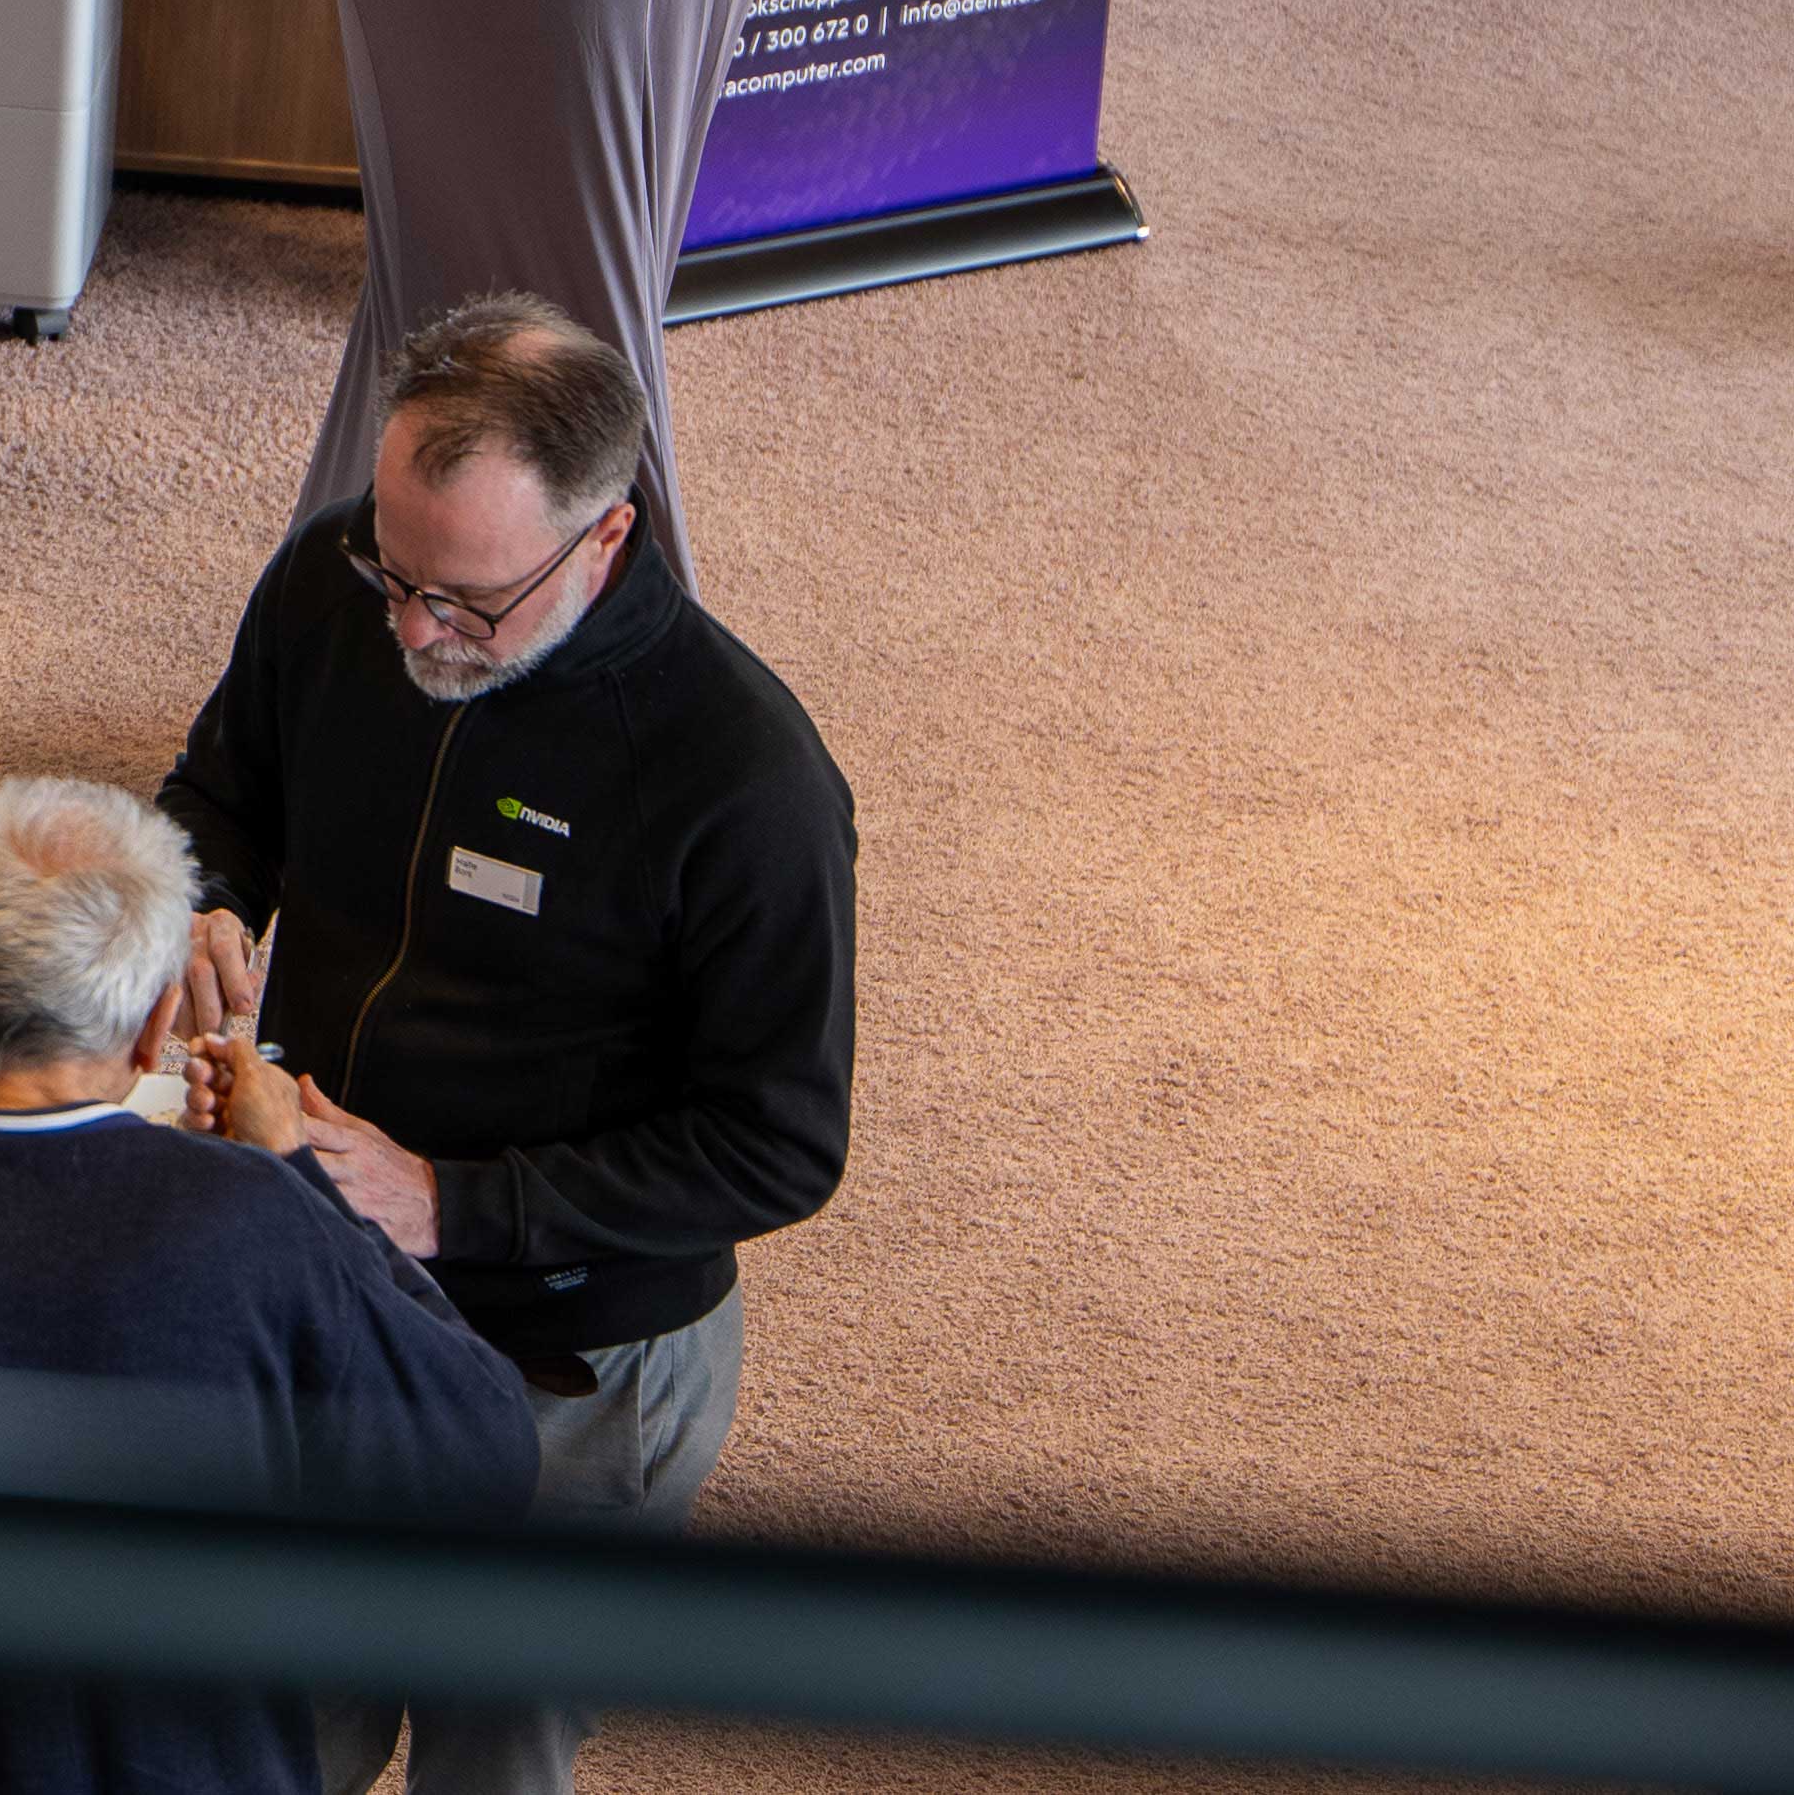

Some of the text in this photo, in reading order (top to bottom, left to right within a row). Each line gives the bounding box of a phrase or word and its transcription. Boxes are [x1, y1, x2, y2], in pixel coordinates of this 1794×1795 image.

[767, 25, 807, 52] 300
[813, 17, 851, 45] 672
[856, 13, 870, 37] 0
